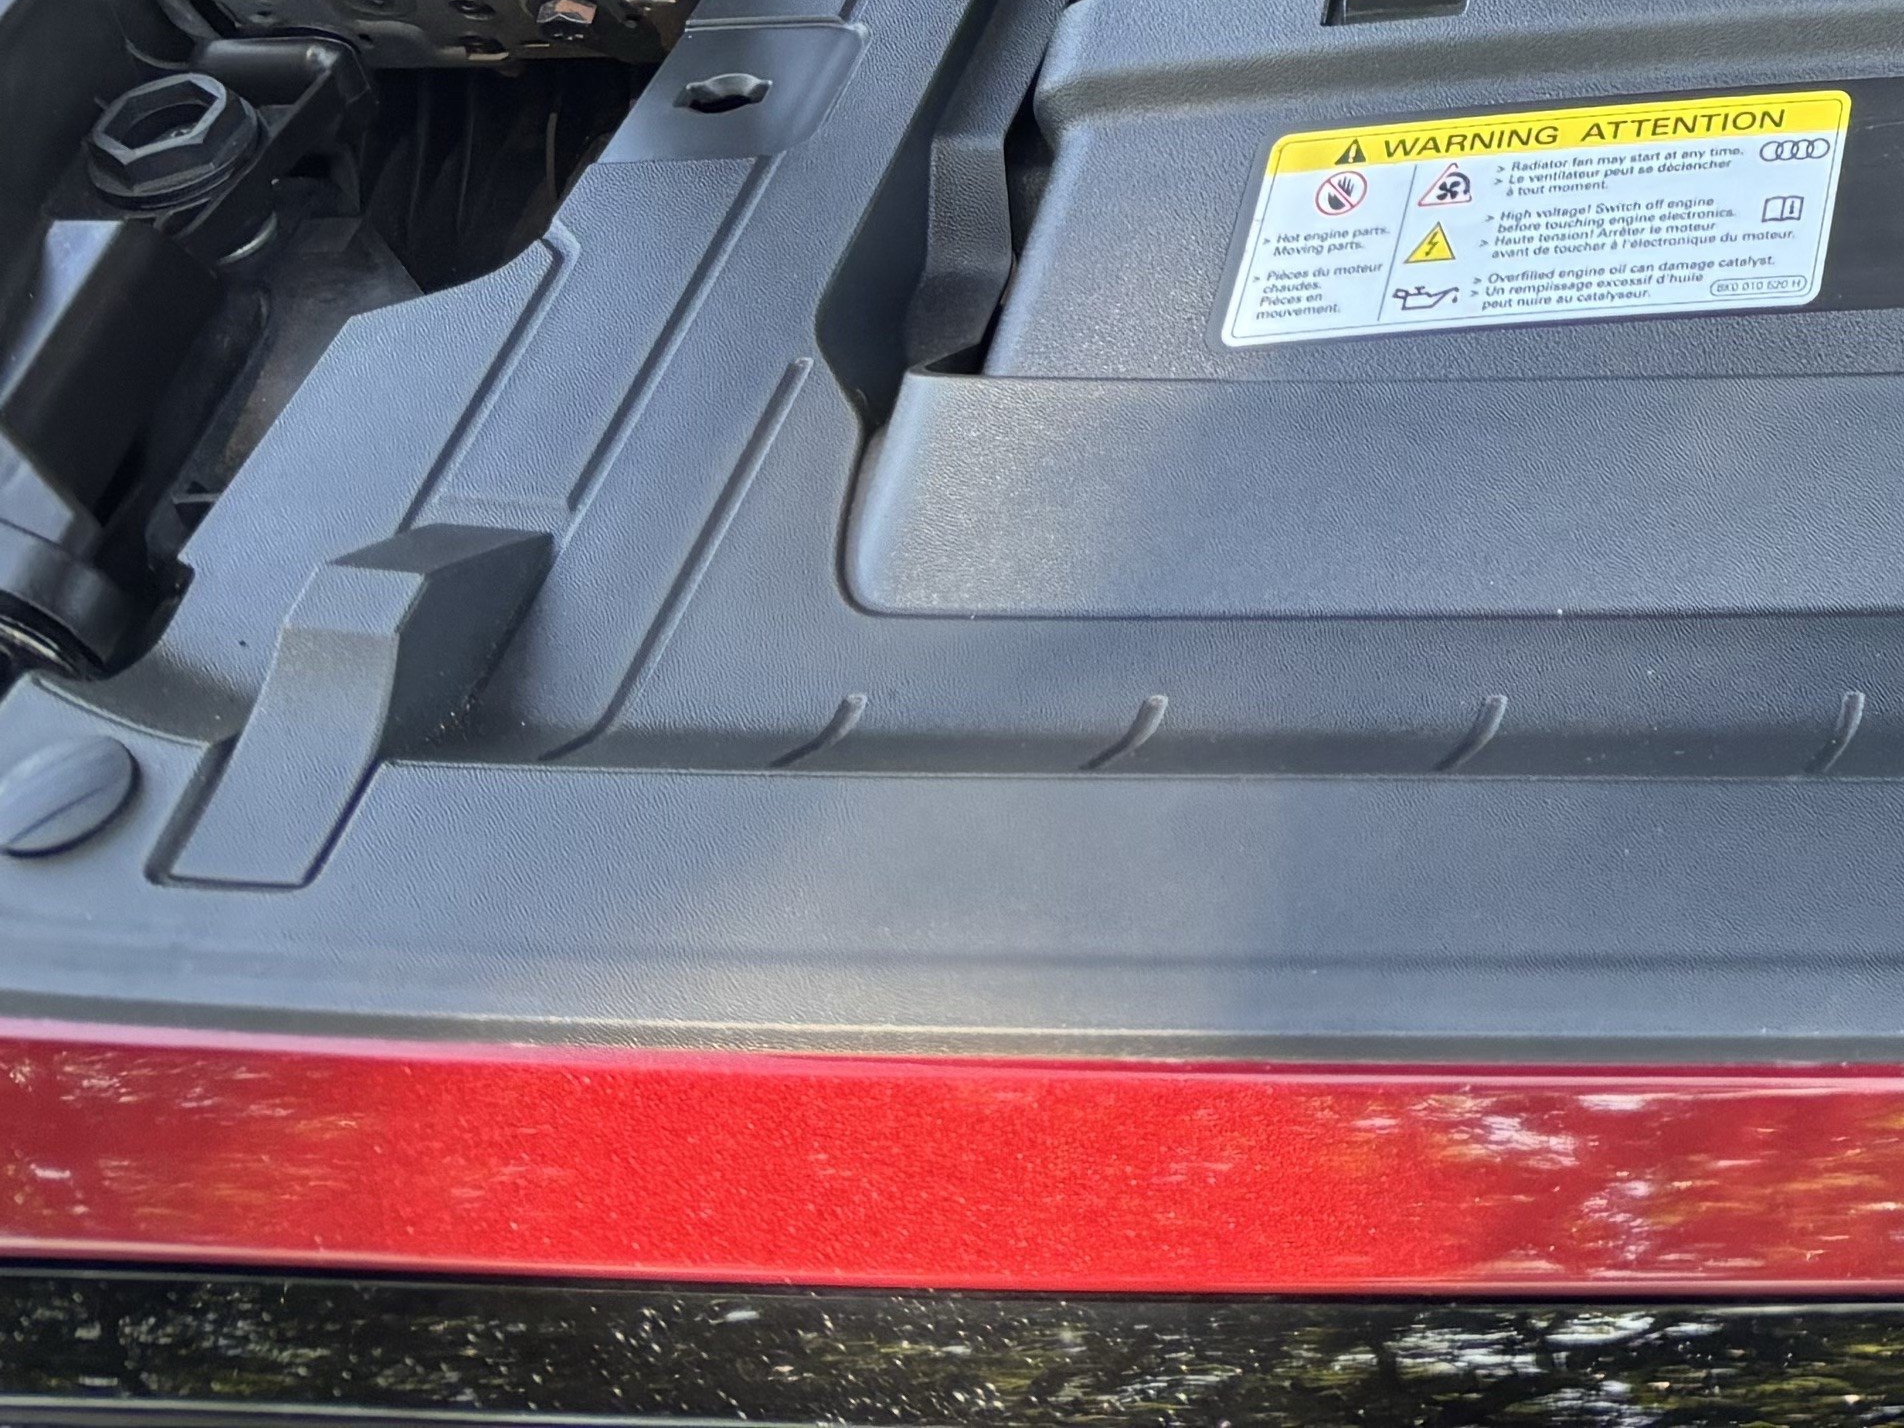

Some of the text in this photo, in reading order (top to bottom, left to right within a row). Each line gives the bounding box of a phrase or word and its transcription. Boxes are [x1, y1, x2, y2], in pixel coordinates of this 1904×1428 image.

[1384, 108, 1785, 158] WARNING ATTENTION
[1511, 146, 1744, 173] Radiator fan may start at any time.
[1508, 173, 1524, 185] Le
[1529, 169, 1600, 183] ventilateur
[1604, 164, 1634, 179] peut
[1637, 164, 1653, 175] se
[1518, 185, 1544, 196] tout
[1548, 180, 1608, 193] moment.
[1500, 197, 1714, 224] High voltage! Switch off engine
[1494, 234, 1534, 246] Haute
[1538, 229, 1594, 243] tension!
[1650, 225, 1662, 235] le
[1666, 222, 1716, 234] moteur
[1497, 221, 1541, 234] before
[1545, 216, 1605, 231] touching
[1609, 213, 1655, 227] engine
[1276, 232, 1301, 244] Hot
[1303, 229, 1349, 244] engine
[1491, 247, 1529, 259] avant
[1533, 246, 1550, 256] de
[1554, 242, 1606, 255] toucher
[1720, 232, 1738, 242] du
[1742, 230, 1795, 241] moteur.
[1273, 243, 1324, 257] Moving
[1312, 266, 1330, 277] du
[1333, 263, 1384, 276] moteur
[1487, 255, 1775, 284] Overfilled engine oil can damage catalyst.
[1263, 281, 1322, 294] chaudes.
[1485, 286, 1505, 297] Un
[1509, 280, 1593, 295] remplissage
[1596, 274, 1654, 288] excessif
[1306, 293, 1323, 303] en
[1482, 289, 1650, 311] peut nuire au catalyseur.
[1256, 303, 1341, 321] mouvement.
